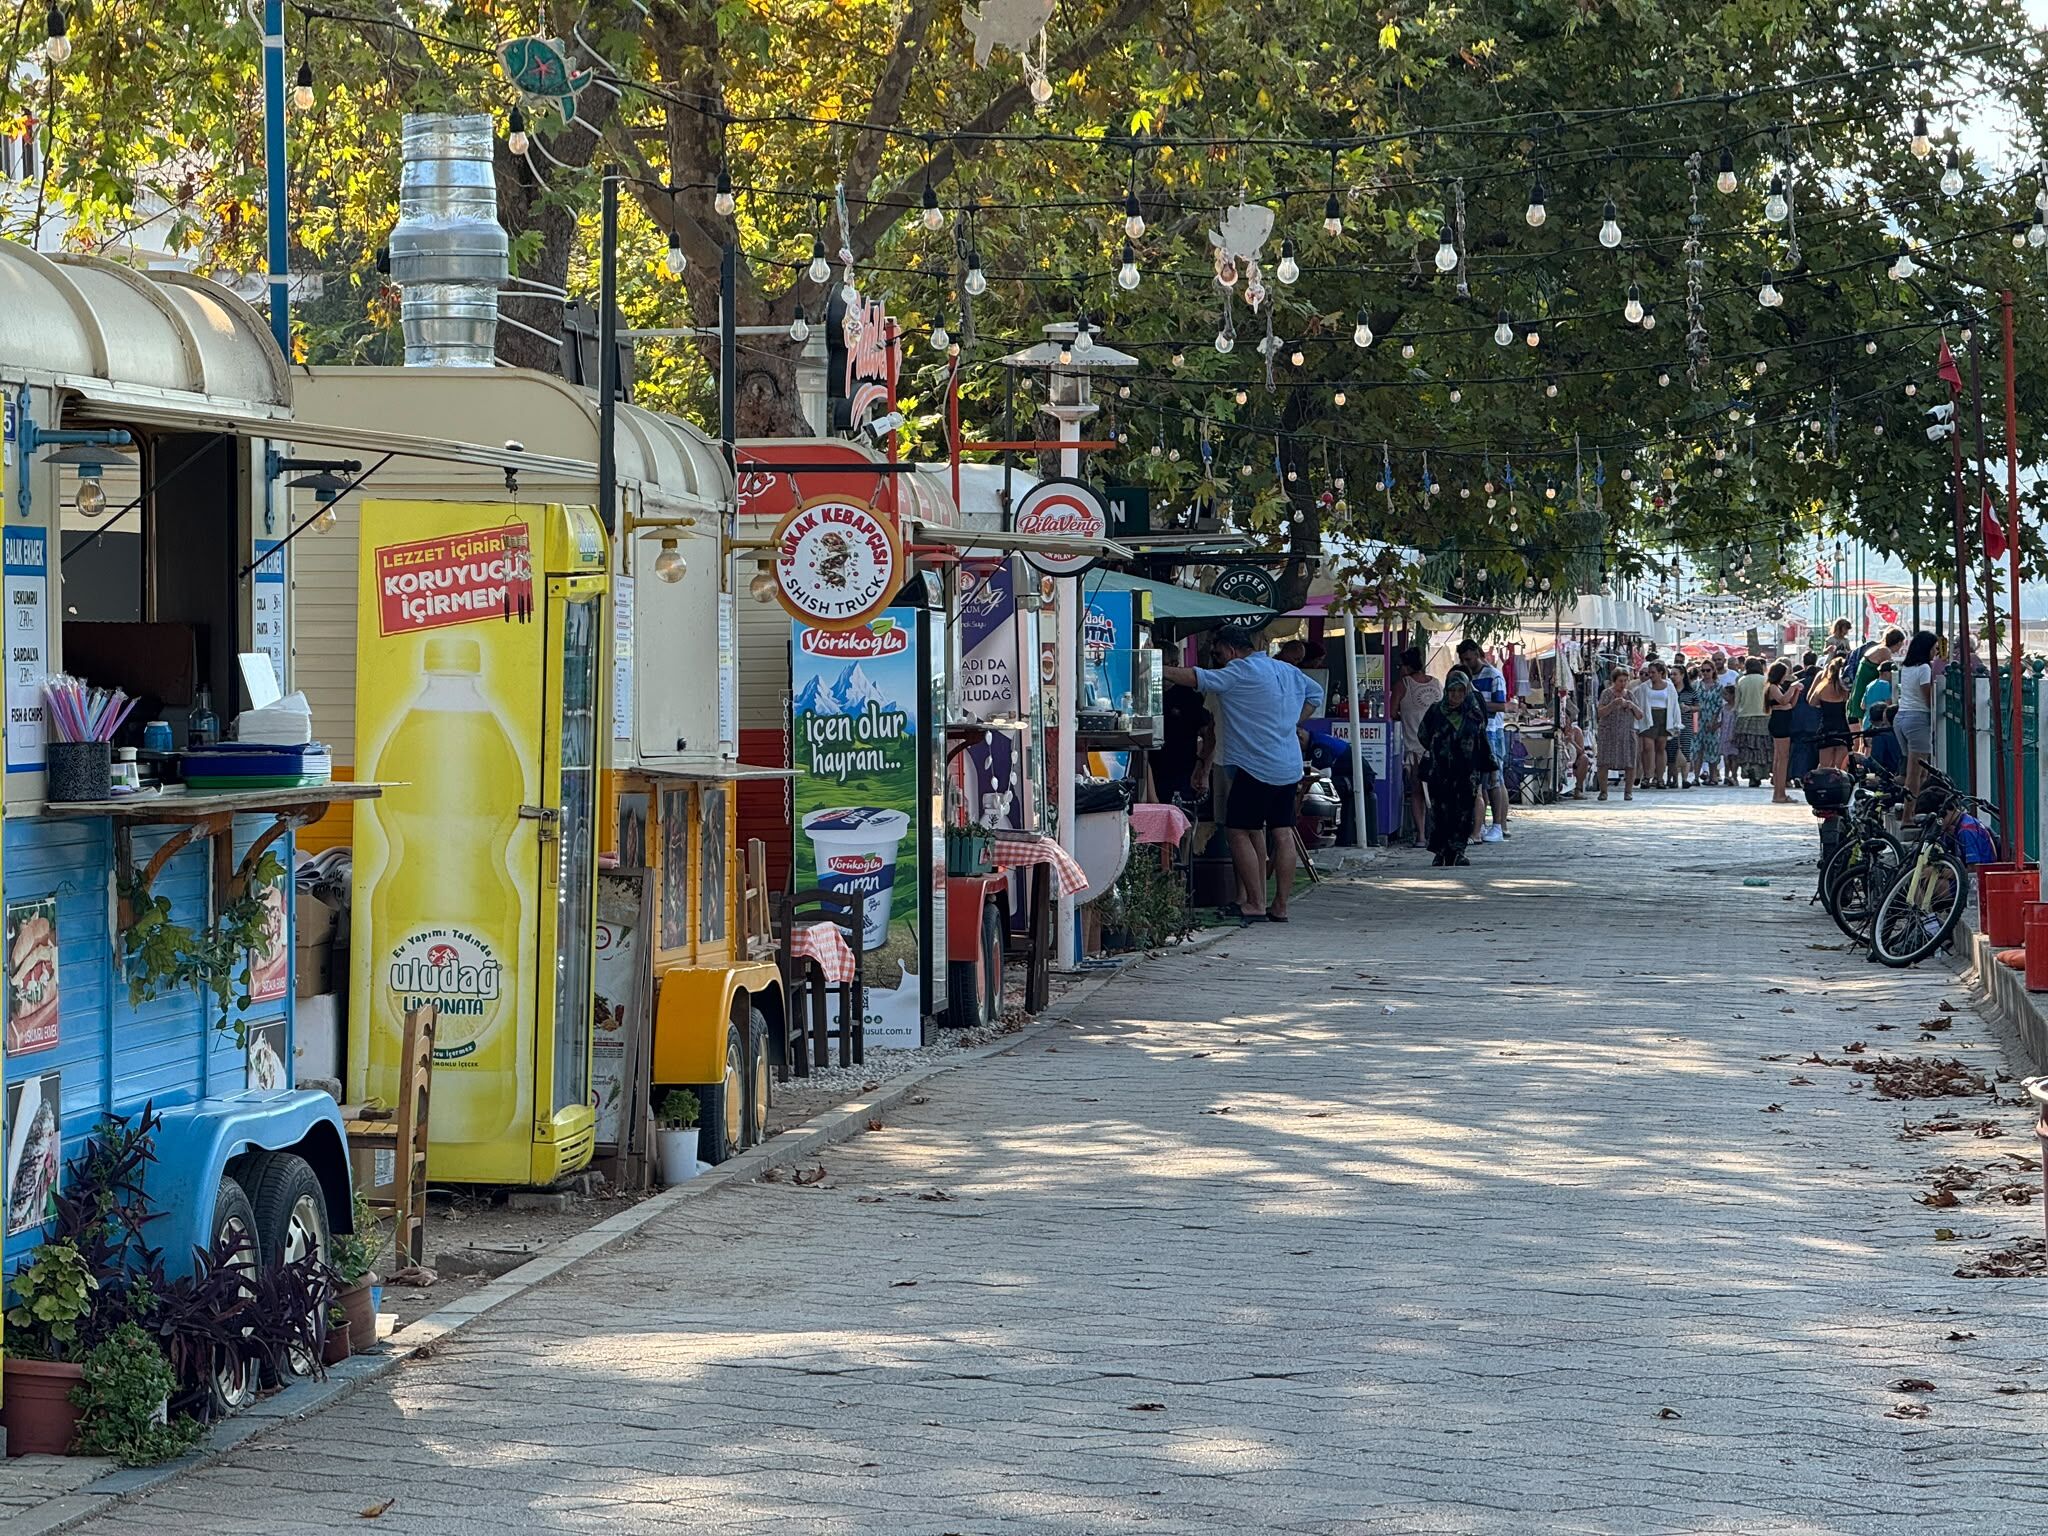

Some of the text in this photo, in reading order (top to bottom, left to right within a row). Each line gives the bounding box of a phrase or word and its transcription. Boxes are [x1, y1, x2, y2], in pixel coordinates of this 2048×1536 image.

[1019, 514, 1102, 533] PilaVento
[781, 508, 888, 566] SOKAK KEBAPÇISI
[5, 538, 44, 566] BALIK EKMEK
[383, 547, 444, 568] LEZZET
[385, 555, 520, 597] KORUYUCU
[1223, 574, 1266, 592] COFFEE
[13, 590, 37, 605] USKUMRU
[401, 585, 508, 624] İÇİRMEM
[786, 575, 885, 615] SHISH TRUCK
[1226, 615, 1262, 626] AVE
[13, 648, 39, 661] SARDALYA
[988, 659, 1006, 670] DA
[961, 674, 1010, 686] ADI DA
[12, 708, 22, 722] FISH
[28, 708, 43, 722] CHIPS
[806, 703, 904, 747] içen olur
[1333, 726, 1381, 739] KAR RBETİ
[812, 743, 901, 782] hayranı...
[392, 929, 492, 959] Ev Yapımı Tadında
[390, 957, 500, 1001] uludağ
